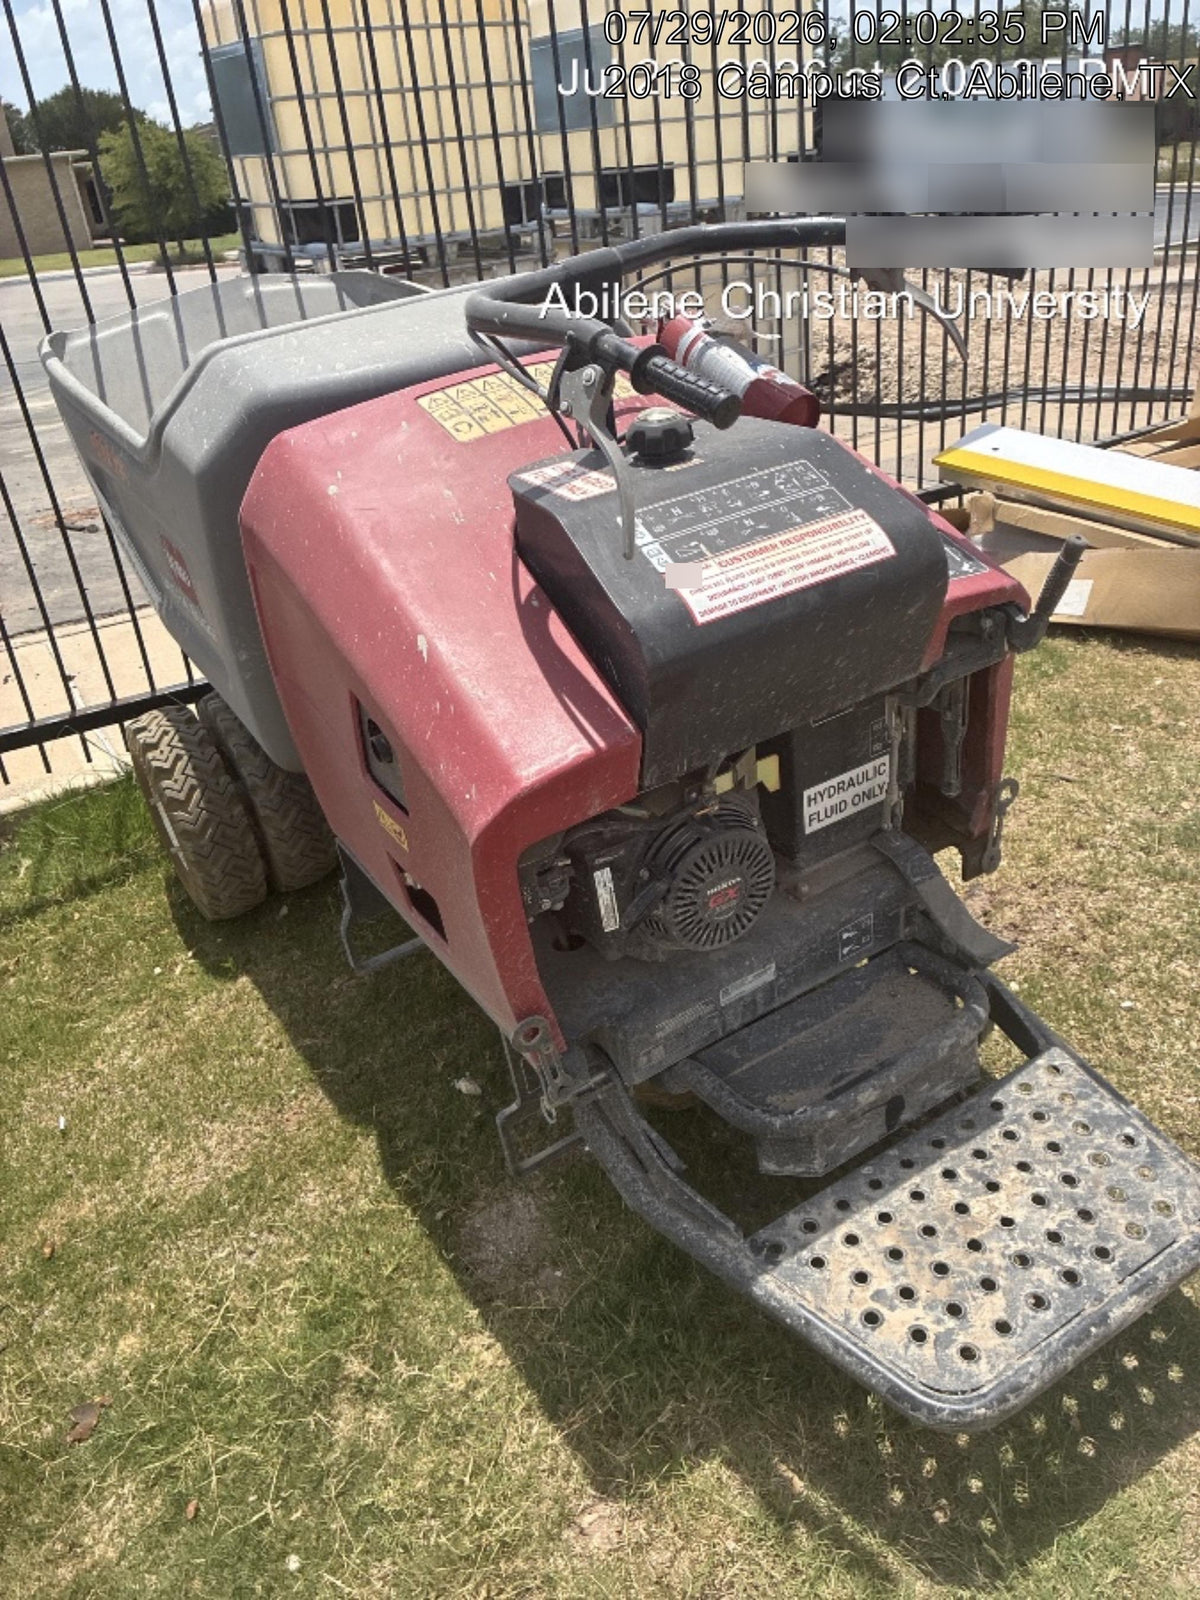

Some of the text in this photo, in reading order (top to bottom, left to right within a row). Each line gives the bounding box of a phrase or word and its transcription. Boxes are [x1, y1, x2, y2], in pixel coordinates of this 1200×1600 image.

[806, 762, 888, 808] HYDRAULIC
[808, 781, 887, 828] FLUID ONLY
